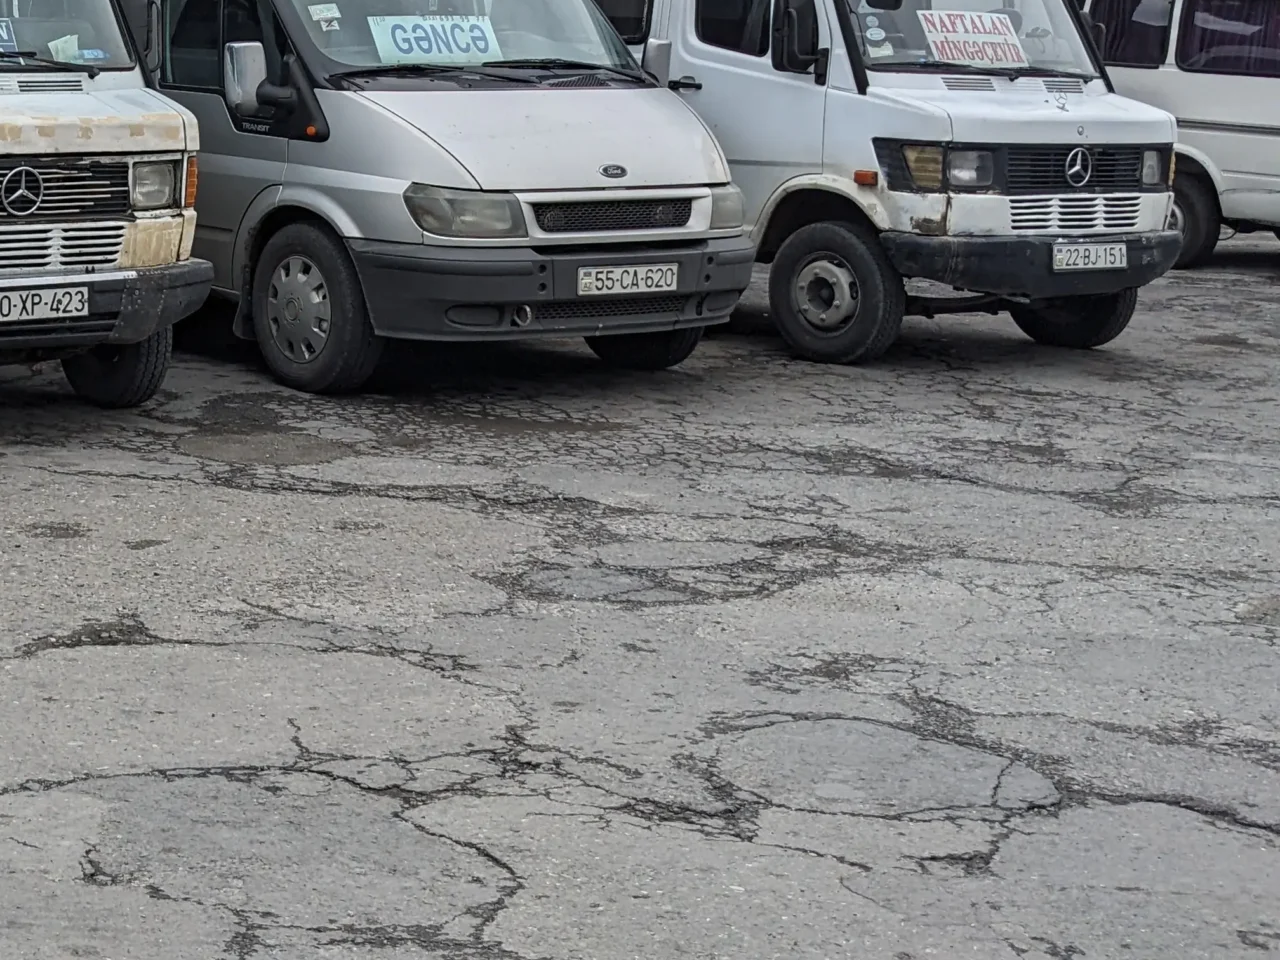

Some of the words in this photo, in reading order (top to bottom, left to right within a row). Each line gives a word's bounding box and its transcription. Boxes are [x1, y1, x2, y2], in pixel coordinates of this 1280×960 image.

[920, 12, 1014, 37] NAFTALAN
[390, 23, 490, 55] GƏNCƏ
[932, 35, 1026, 65] MİNGƏÇEVİR
[241, 121, 270, 132] TRANSIT
[1065, 247, 1123, 267] 22-BJ-151
[594, 267, 674, 292] 55-CA-620
